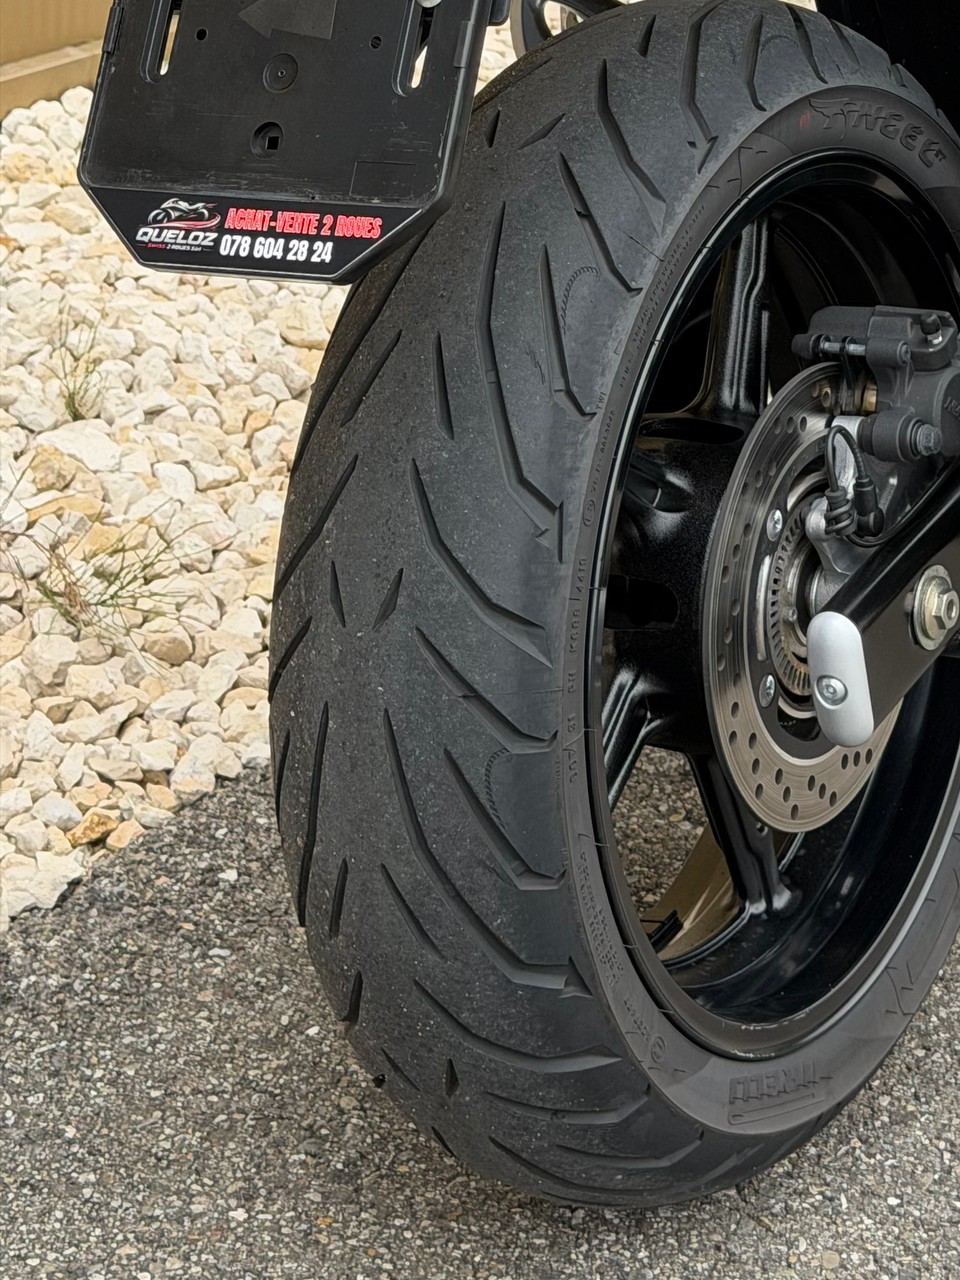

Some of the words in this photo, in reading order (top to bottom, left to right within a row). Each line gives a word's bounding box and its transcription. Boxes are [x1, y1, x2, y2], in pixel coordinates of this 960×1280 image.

[135, 227, 218, 247] QUELOZ
[224, 207, 320, 236] ACHAT-VENTE
[320, 214, 333, 236] 2
[334, 215, 383, 239] ROUES
[219, 234, 251, 258] 078
[253, 236, 285, 260] 604
[286, 239, 309, 262] 28
[311, 241, 334, 264] 24
